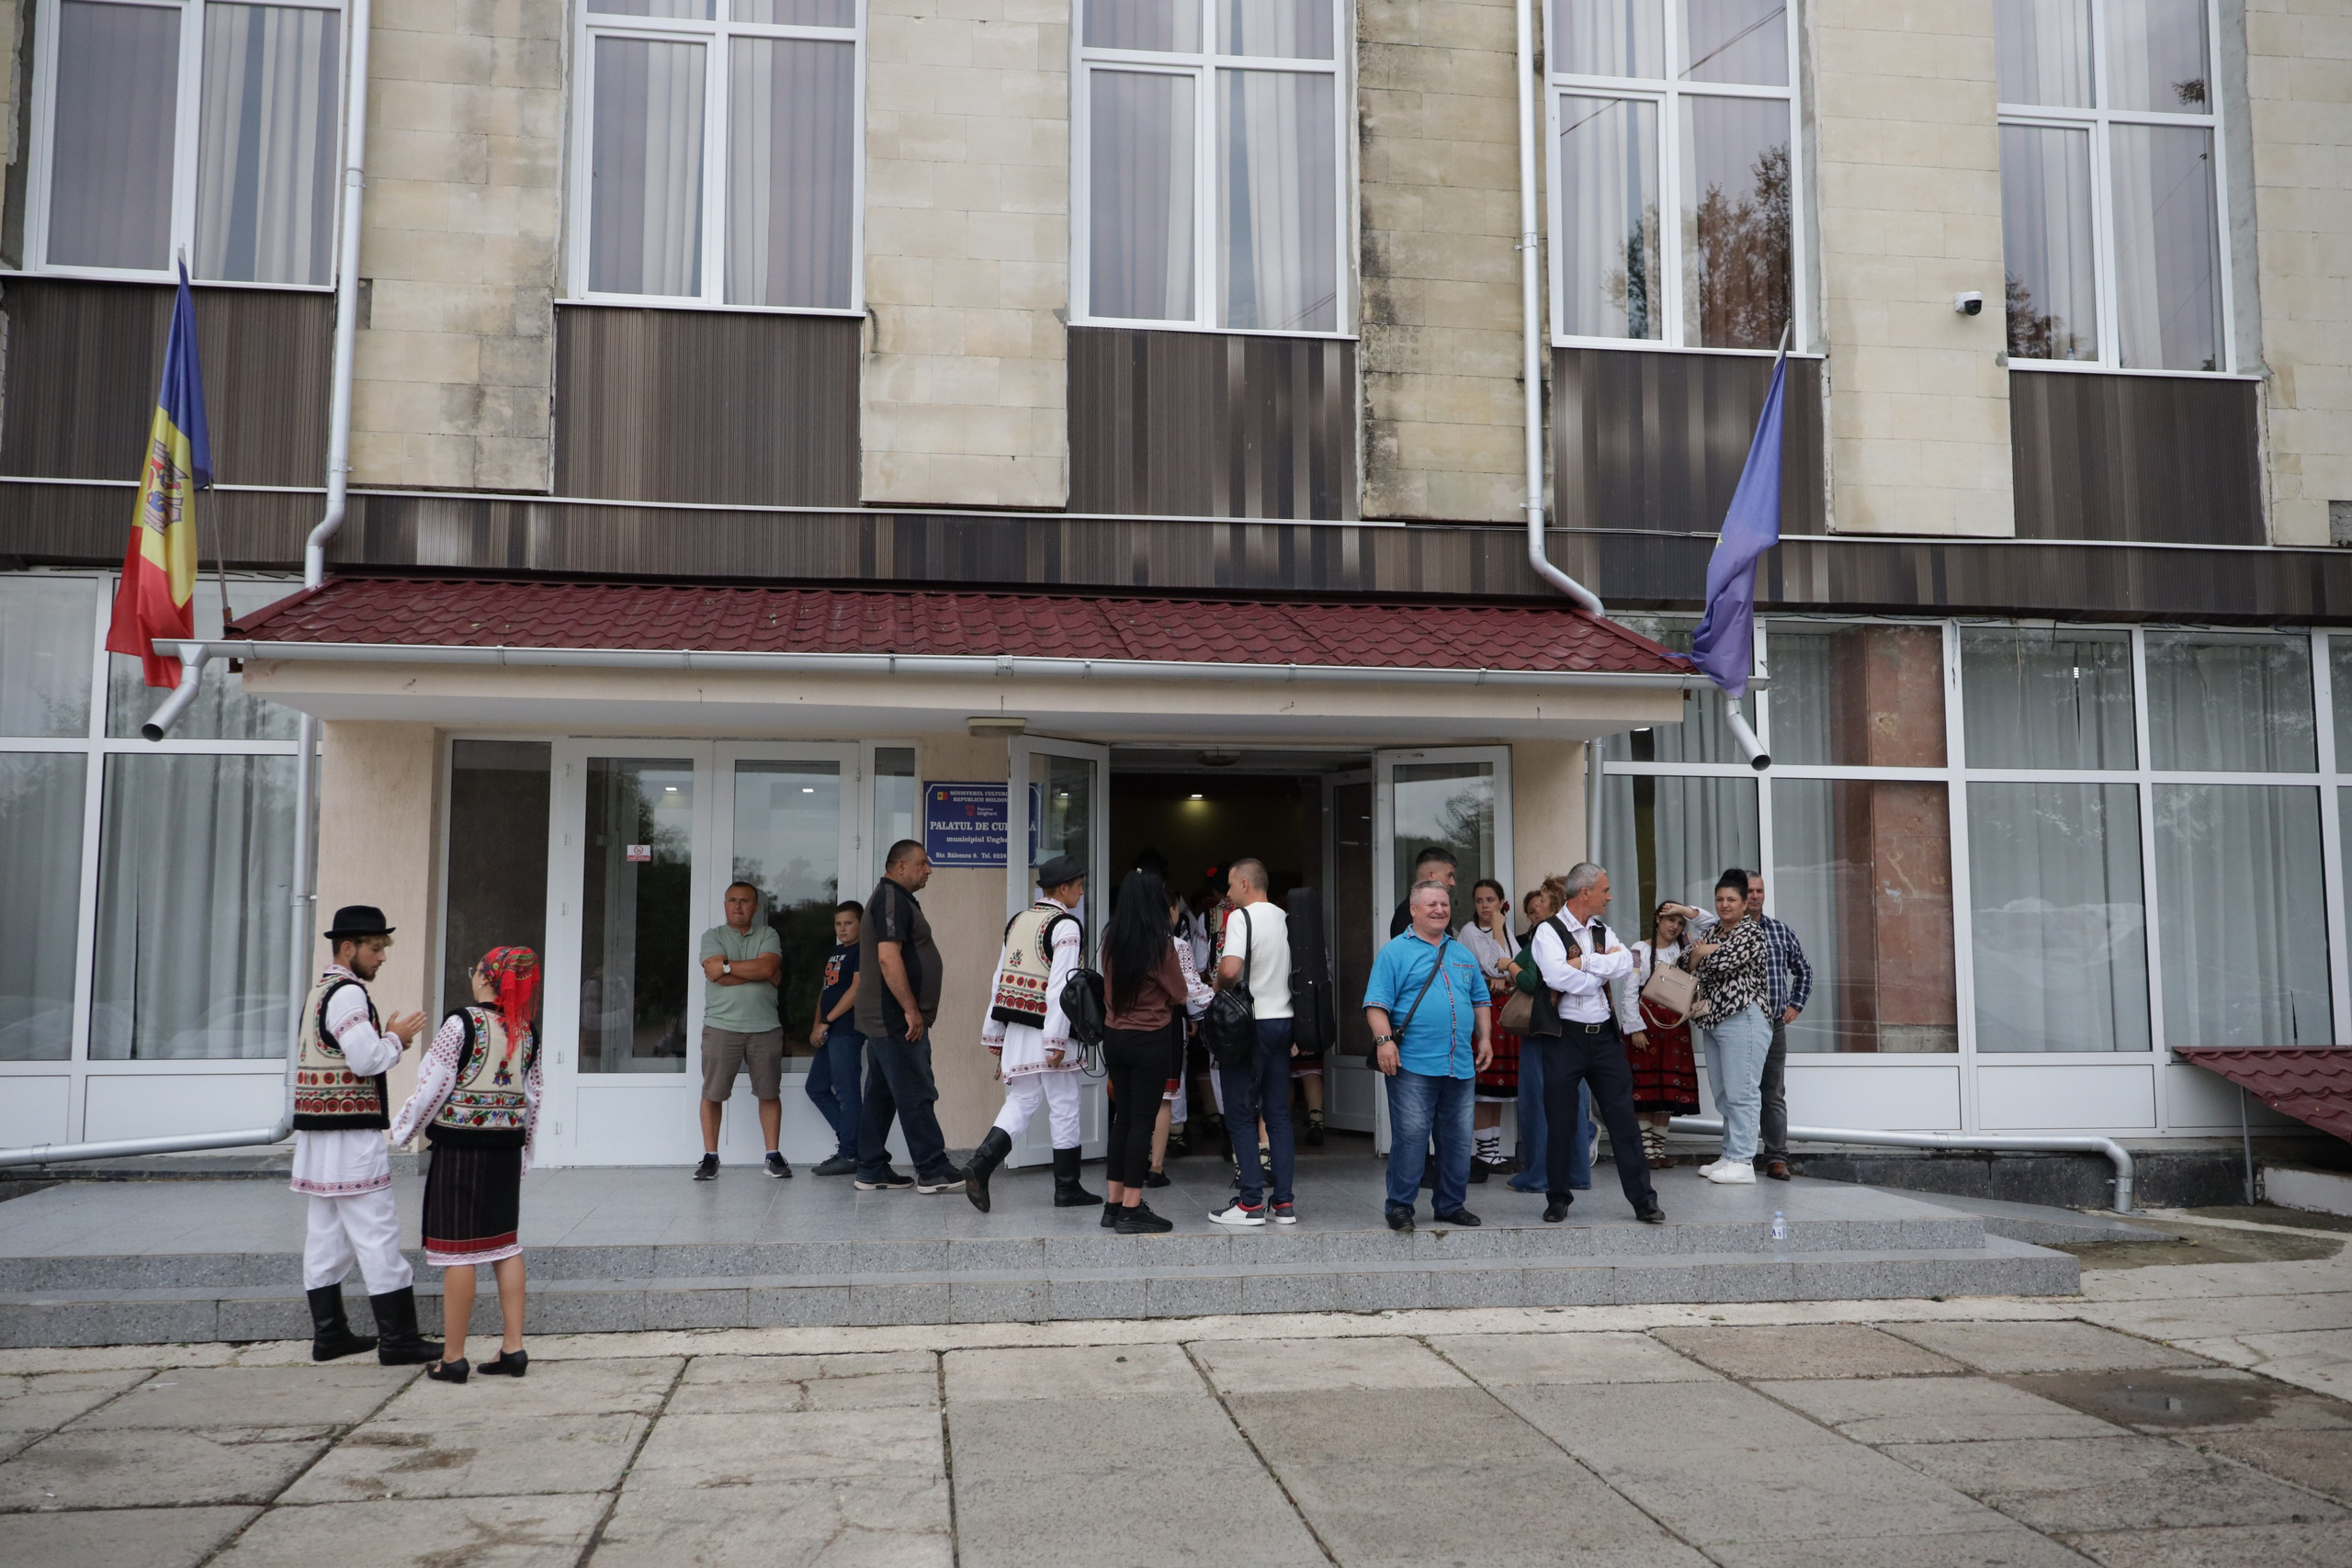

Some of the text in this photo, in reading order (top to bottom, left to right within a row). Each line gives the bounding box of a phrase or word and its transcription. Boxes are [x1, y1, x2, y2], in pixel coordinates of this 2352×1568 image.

[930, 821, 973, 830] PALATUL
[975, 822, 989, 830] DE
[946, 836, 1008, 844] municipiul Unghe
